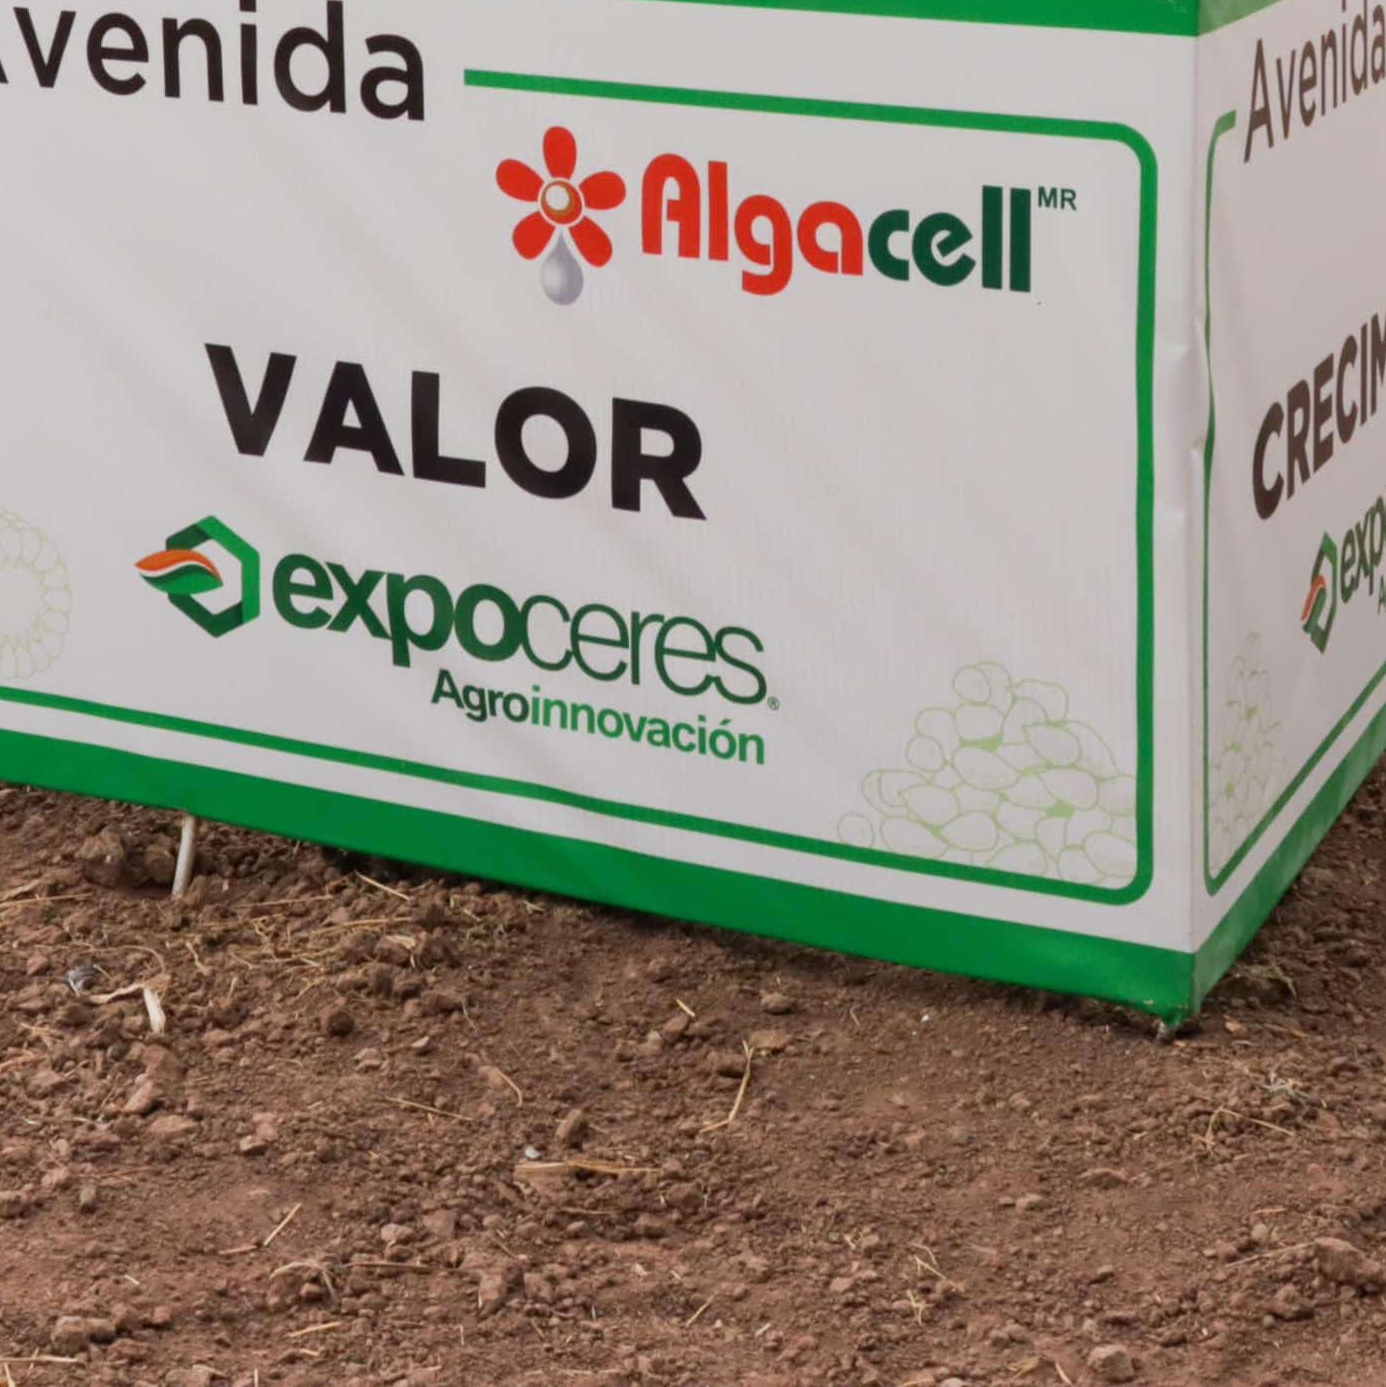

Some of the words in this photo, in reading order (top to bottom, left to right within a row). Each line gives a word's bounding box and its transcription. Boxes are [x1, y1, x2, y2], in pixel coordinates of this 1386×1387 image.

[640, 152, 1031, 296] Algacell
[204, 342, 707, 521] VALOR
[430, 669, 766, 765] Agroinnovación
